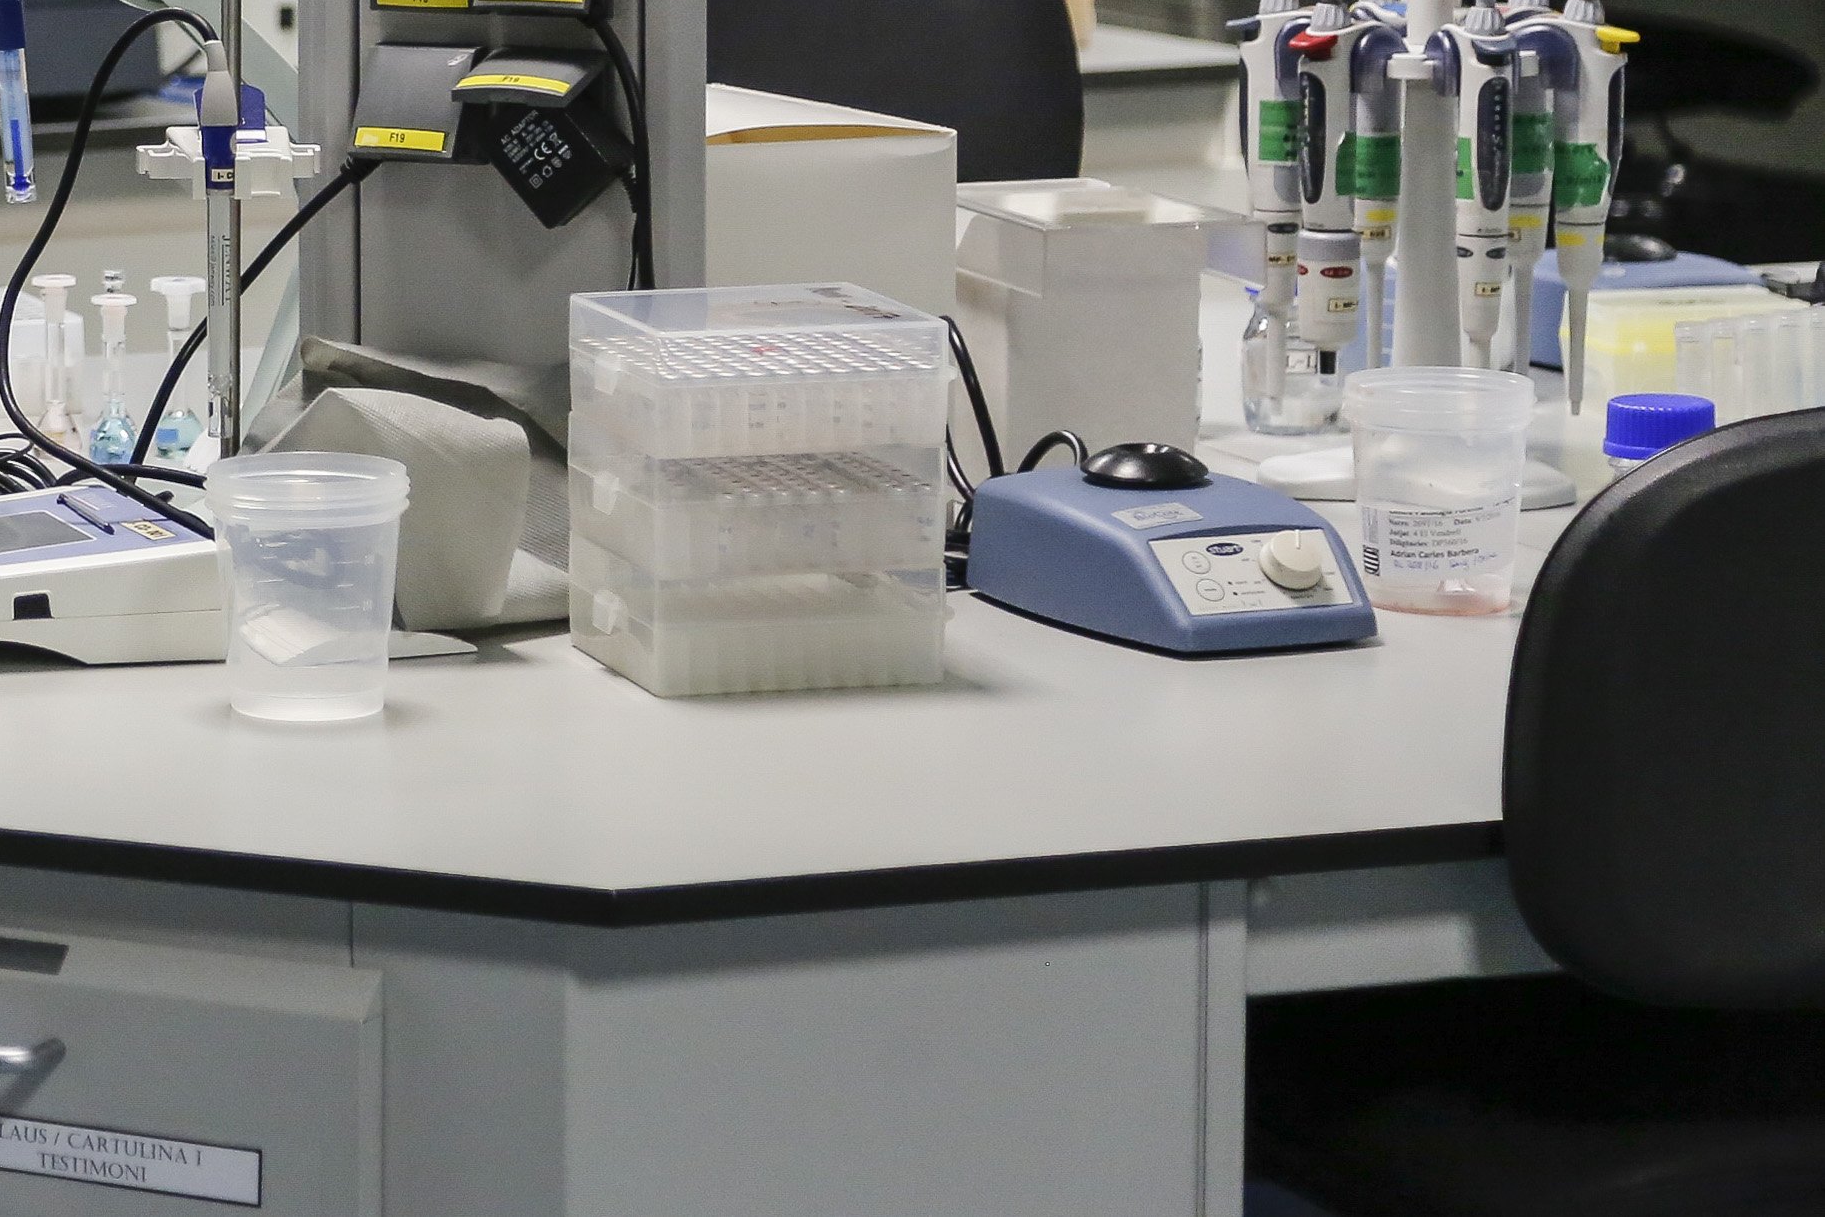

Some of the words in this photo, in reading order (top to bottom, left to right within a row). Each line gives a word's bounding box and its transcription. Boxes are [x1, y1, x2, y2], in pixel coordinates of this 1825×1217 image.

[388, 132, 406, 143] F19
[67, 1134, 188, 1165] CARTULINA
[196, 1150, 203, 1167] I
[37, 1152, 147, 1183] TESTIMONI
